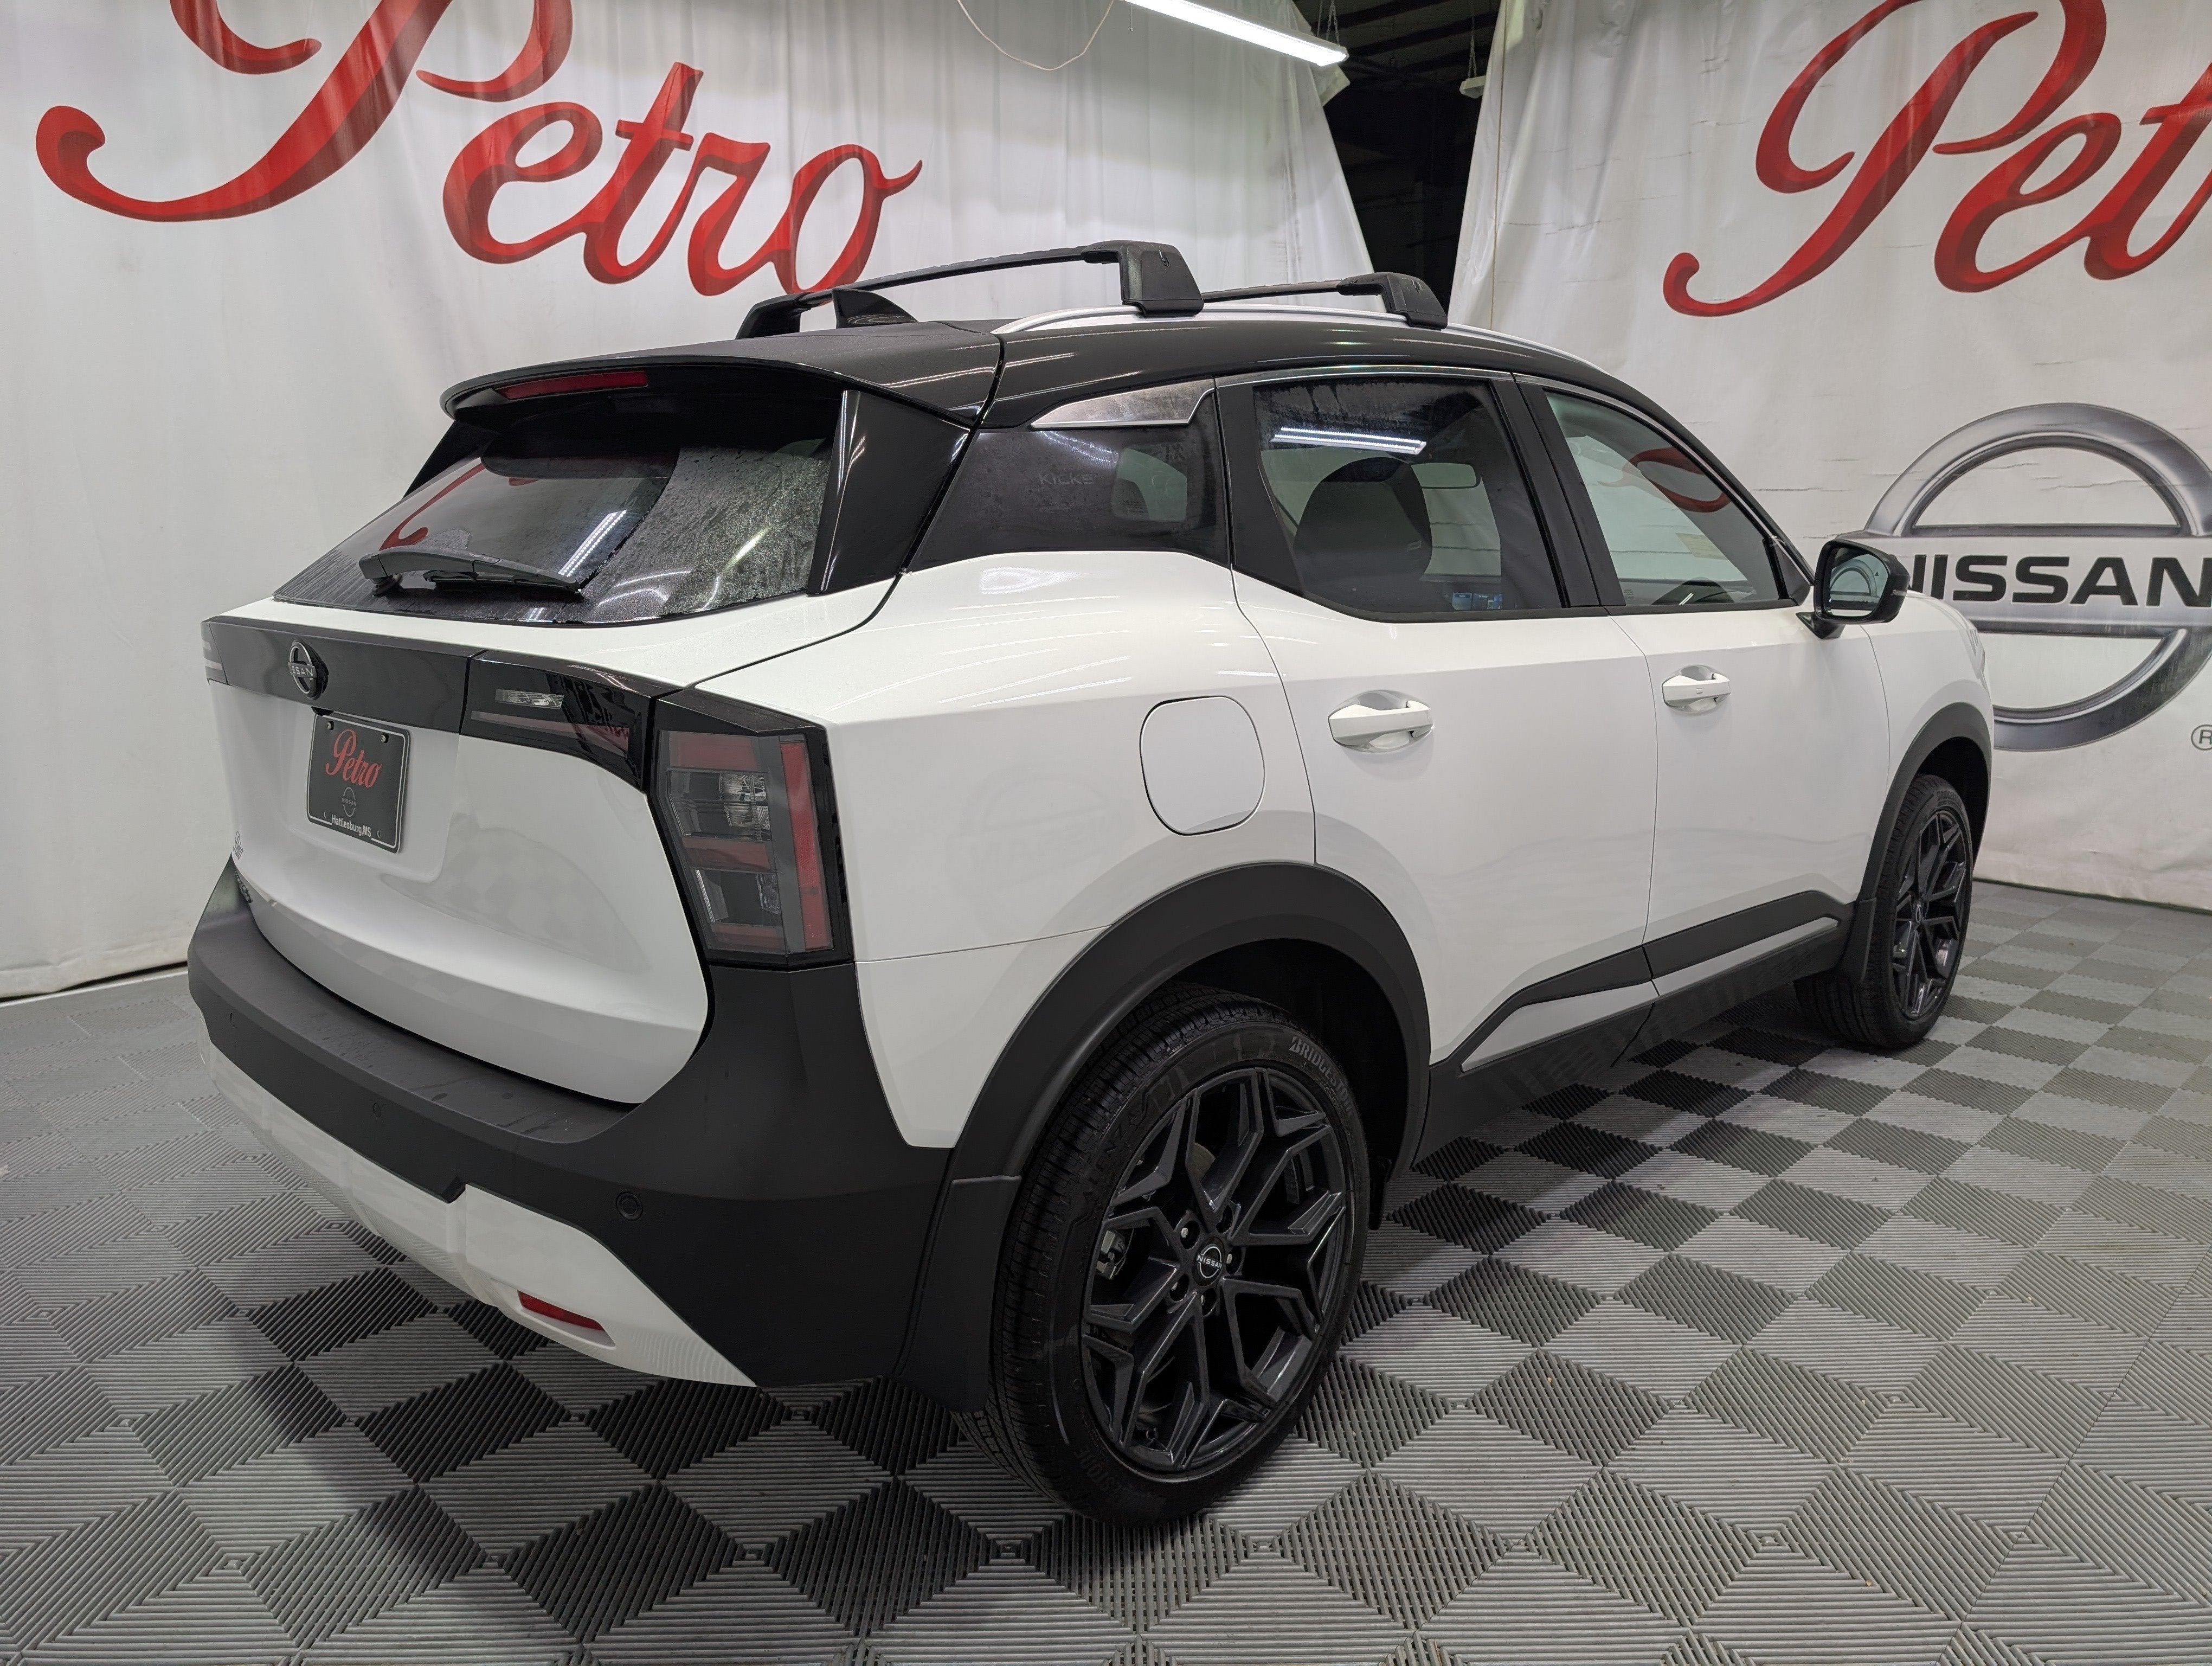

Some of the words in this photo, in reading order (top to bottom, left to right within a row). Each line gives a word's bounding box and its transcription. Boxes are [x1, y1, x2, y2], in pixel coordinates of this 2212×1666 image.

[36, 0, 923, 295] Petro
[1038, 472, 1094, 486] KICKS
[325, 728, 383, 789] Petro
[342, 798, 357, 808] NISSAN
[1197, 1254, 1224, 1270] NISSAN
